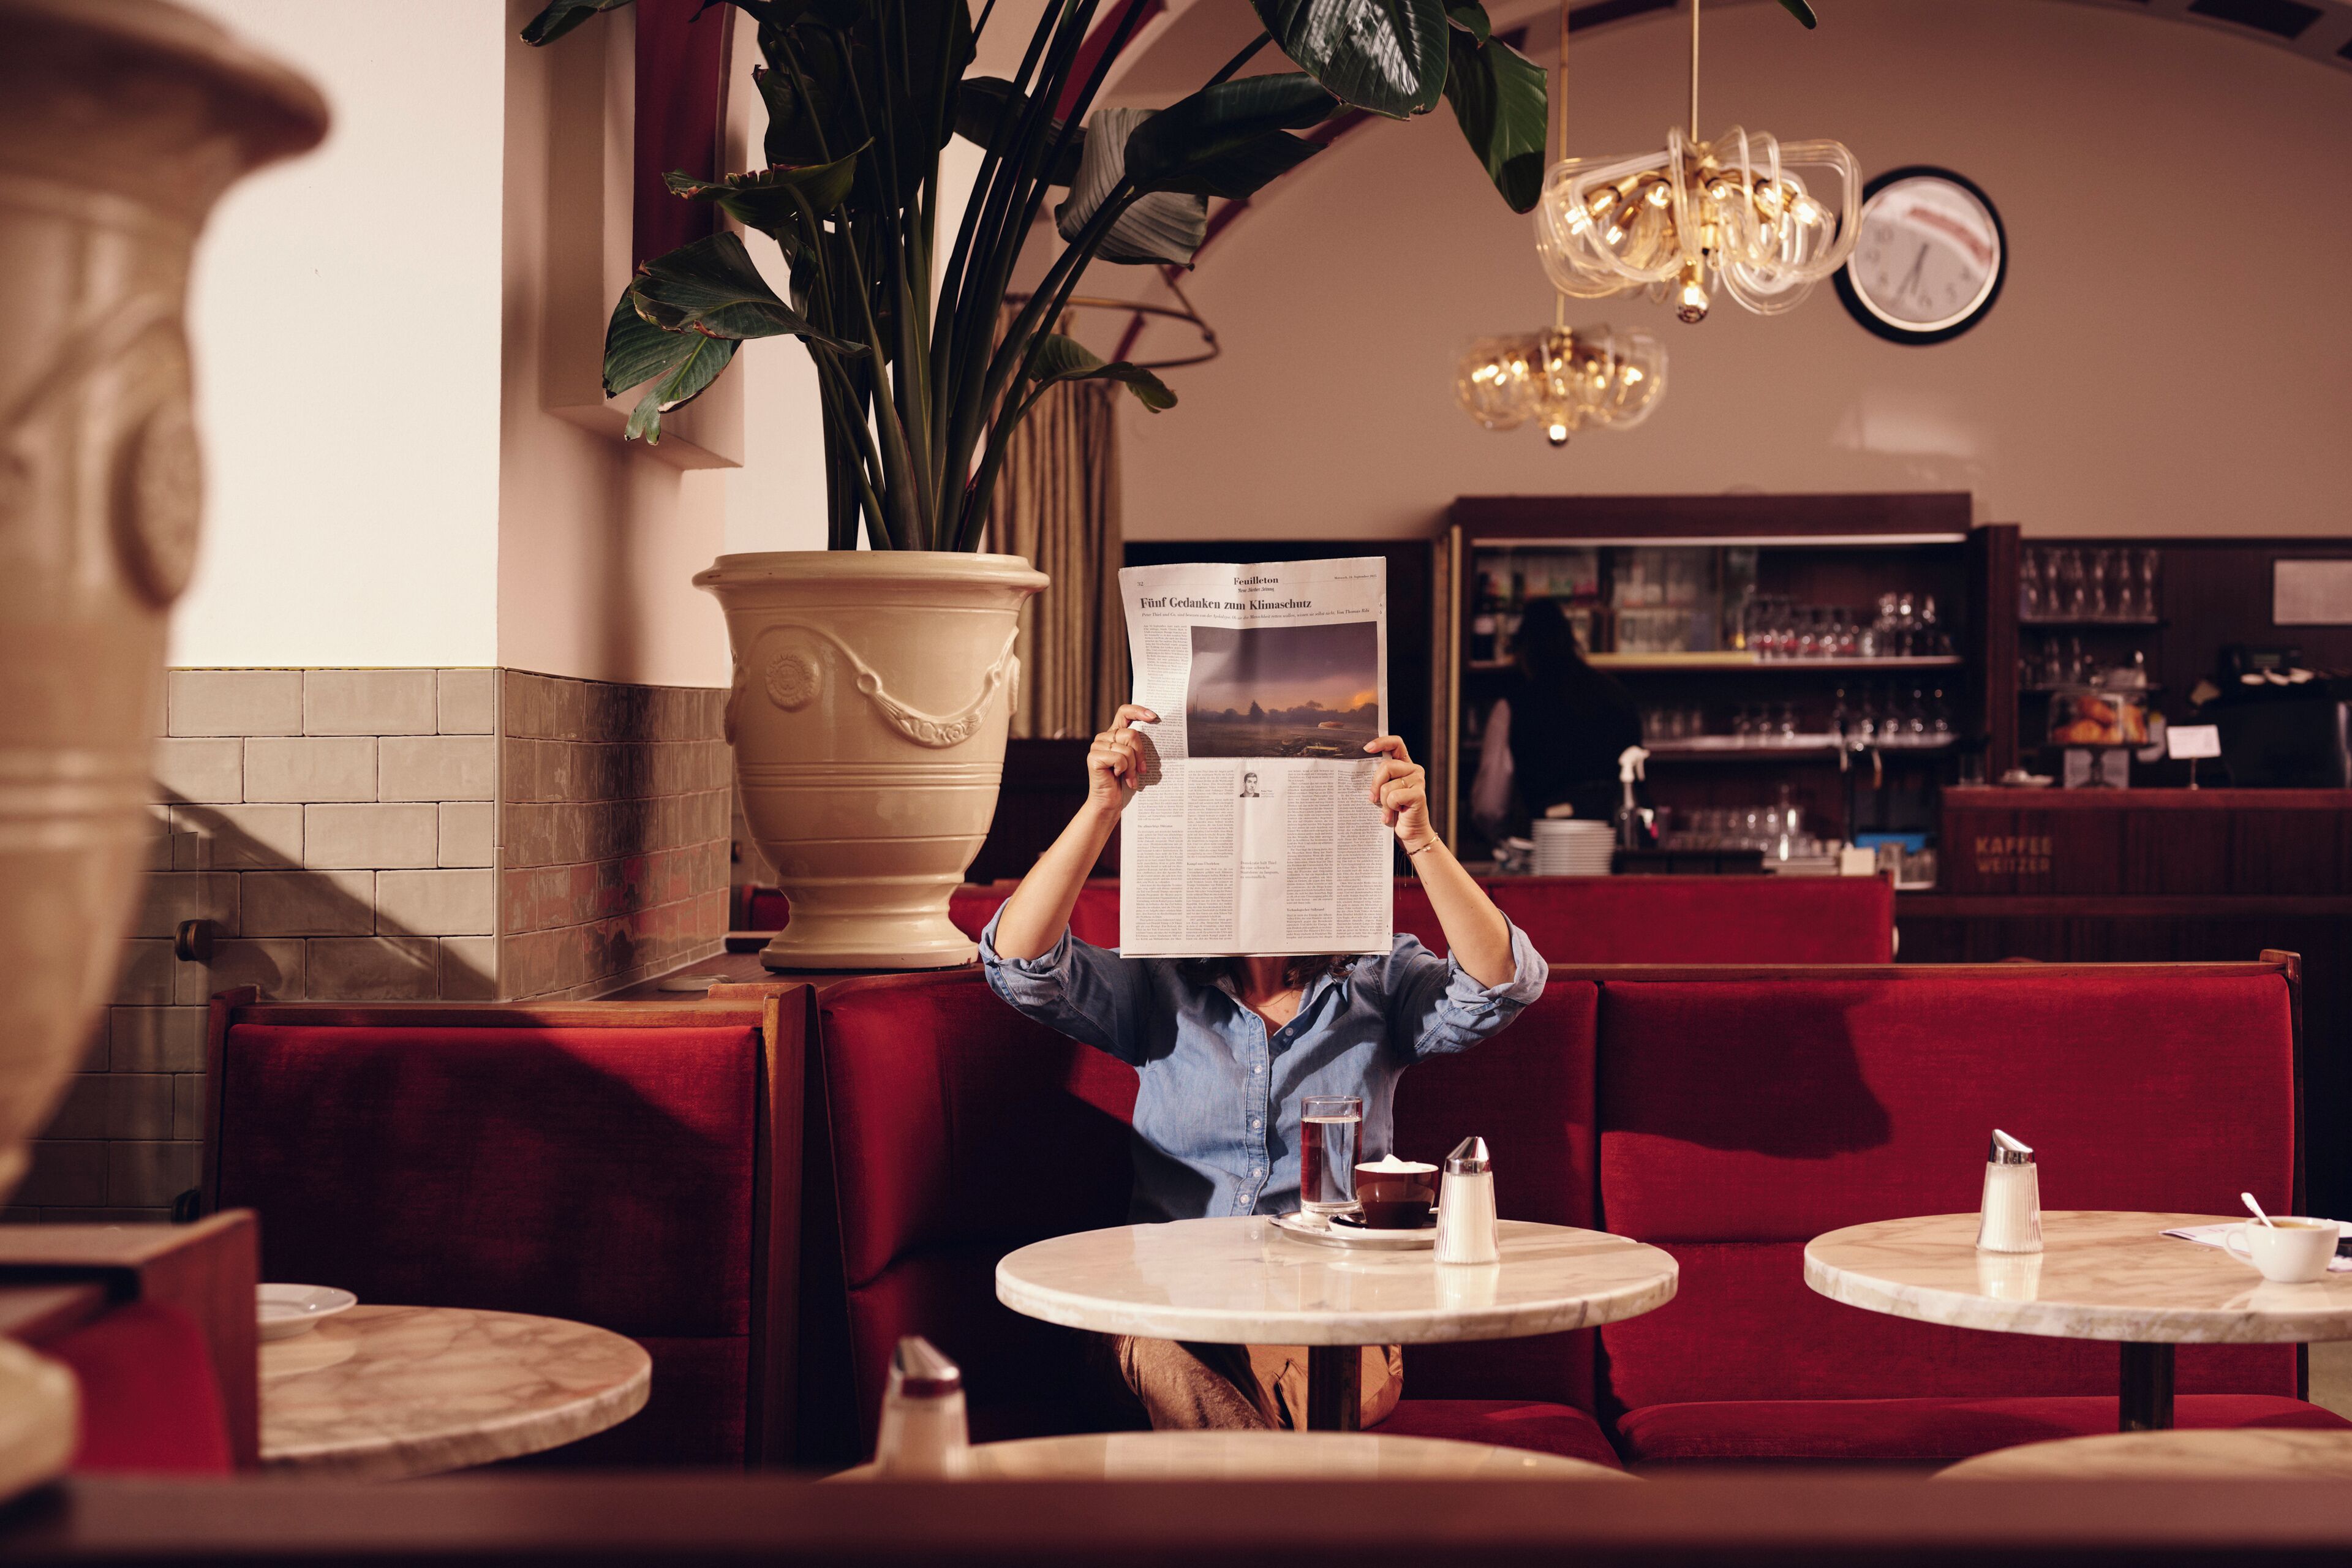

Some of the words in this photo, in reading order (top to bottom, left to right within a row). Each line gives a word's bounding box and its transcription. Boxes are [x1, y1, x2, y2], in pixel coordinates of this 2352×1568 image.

[1234, 576, 1279, 586] Feuilleton
[1140, 597, 1167, 609] Fünf
[1169, 597, 1221, 609] Gedanken
[1224, 601, 1246, 610] zum
[1249, 598, 1312, 610] Klimaschutz
